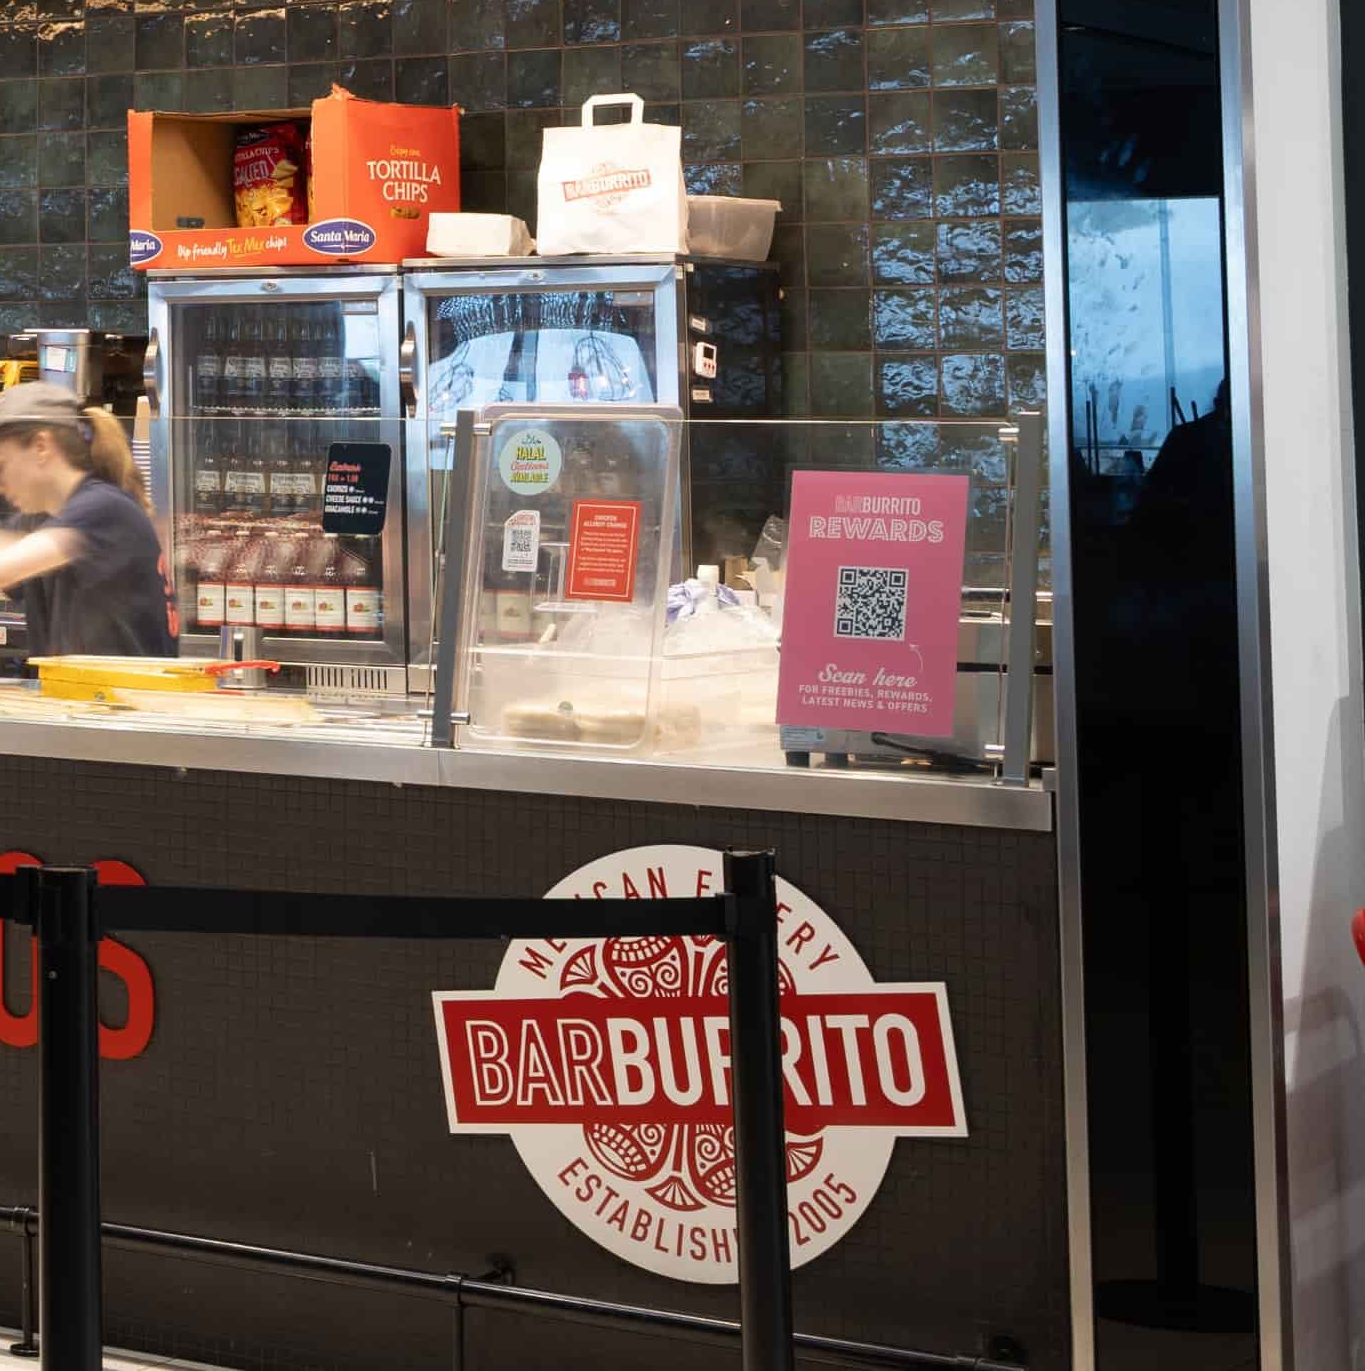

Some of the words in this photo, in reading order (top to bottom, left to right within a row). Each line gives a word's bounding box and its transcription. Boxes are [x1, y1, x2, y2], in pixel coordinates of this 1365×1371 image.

[366, 159, 441, 185] TORTILLA
[383, 181, 428, 203] CHIPS
[310, 230, 342, 243] Santa
[344, 230, 371, 243] Maria
[177, 244, 191, 260] Dip
[191, 239, 228, 261] friendly
[265, 236, 287, 252] chips
[516, 446, 546, 460] HALAL
[510, 470, 549, 484] AVAILABLE
[809, 516, 944, 543] REWARDS
[818, 662, 866, 684] Scan
[872, 667, 918, 687] here
[798, 684, 819, 694] FOR
[821, 685, 874, 699] FREEBIES,
[802, 695, 841, 707] LATEST
[843, 698, 874, 710] NEWS
[876, 700, 884, 710] &
[887, 701, 928, 713] OFFERS
